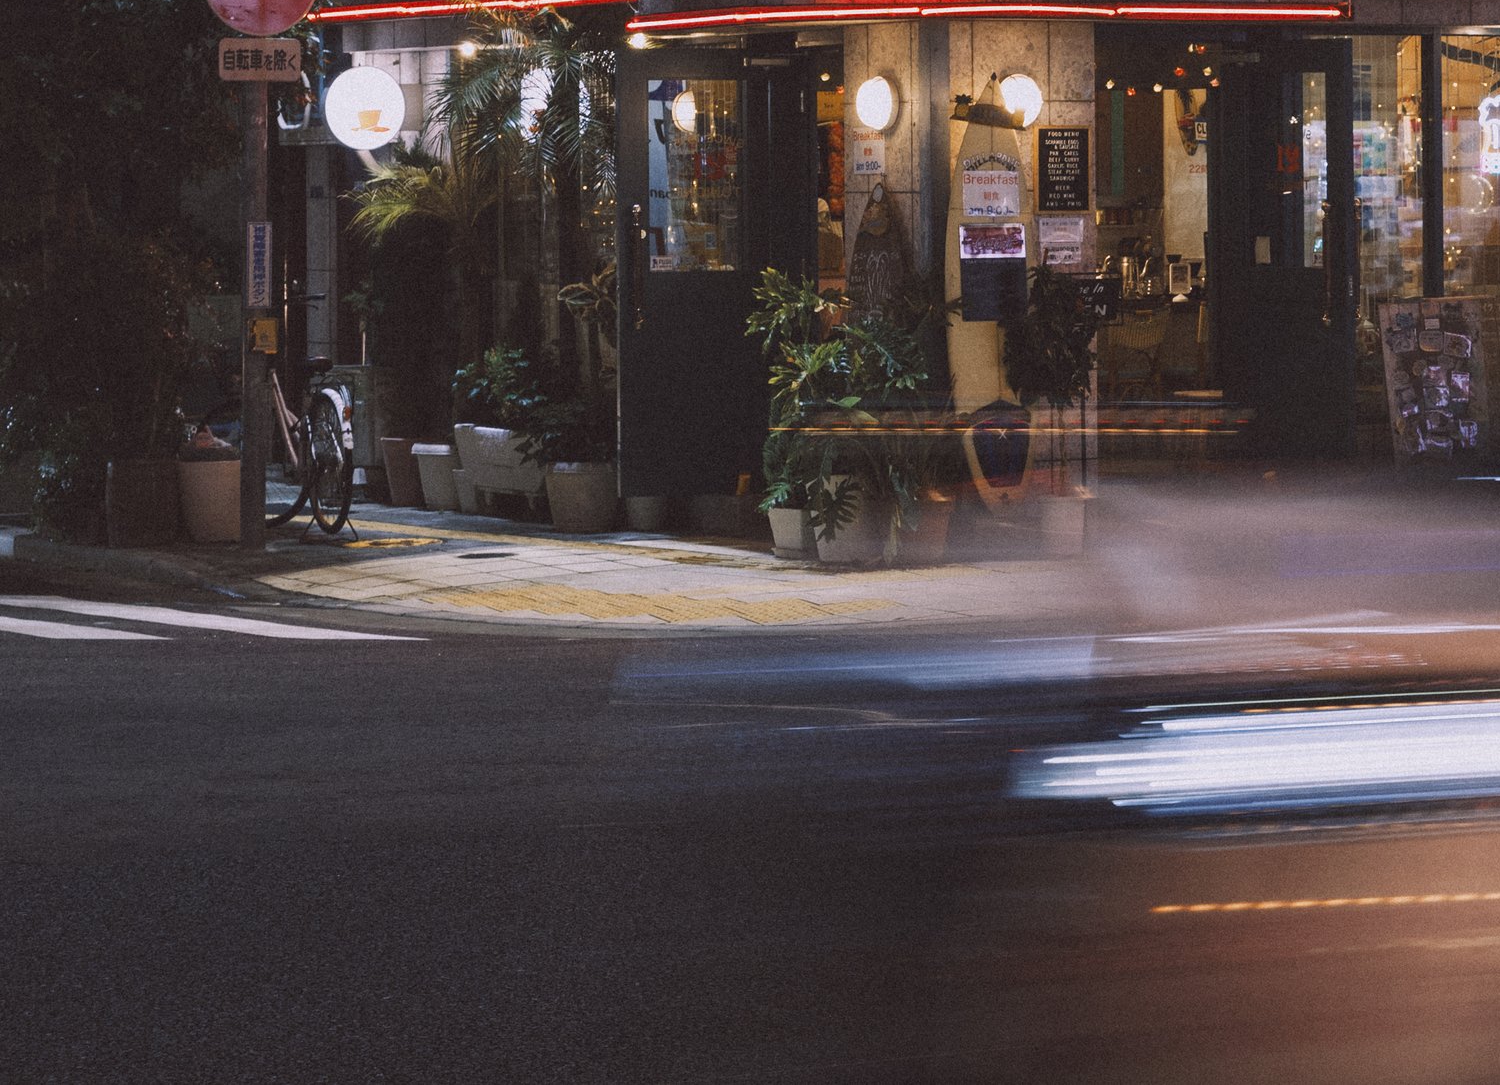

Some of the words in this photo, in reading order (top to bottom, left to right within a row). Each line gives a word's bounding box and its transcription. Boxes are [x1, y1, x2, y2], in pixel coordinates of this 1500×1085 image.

[223, 48, 297, 72] 自転車を除く
[963, 173, 1019, 185] Breakfast
